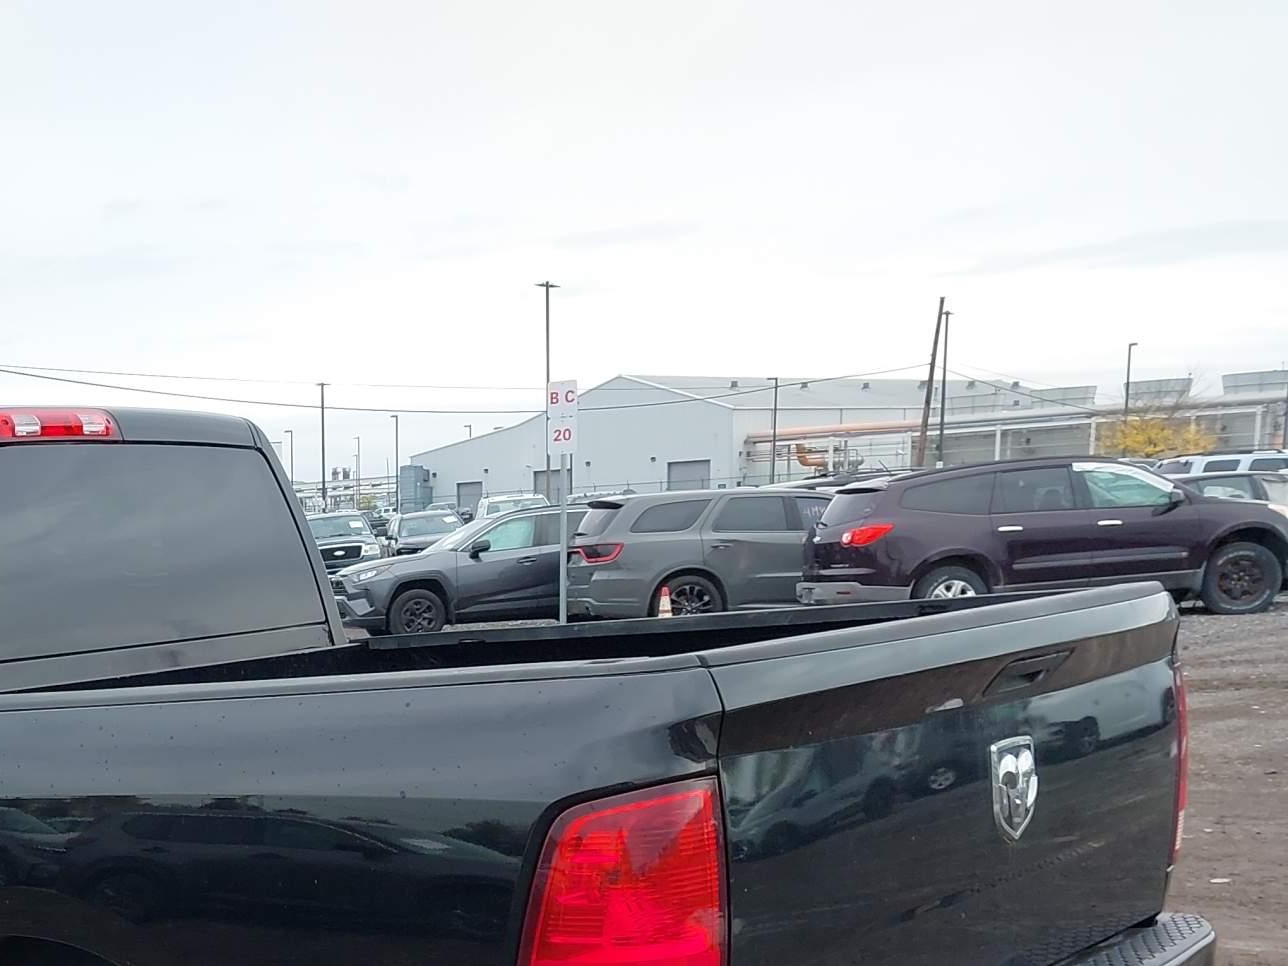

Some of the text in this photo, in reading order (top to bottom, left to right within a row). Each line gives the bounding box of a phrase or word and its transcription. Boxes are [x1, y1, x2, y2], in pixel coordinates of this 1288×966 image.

[550, 390, 575, 405] B C
[553, 429, 572, 442] 20
